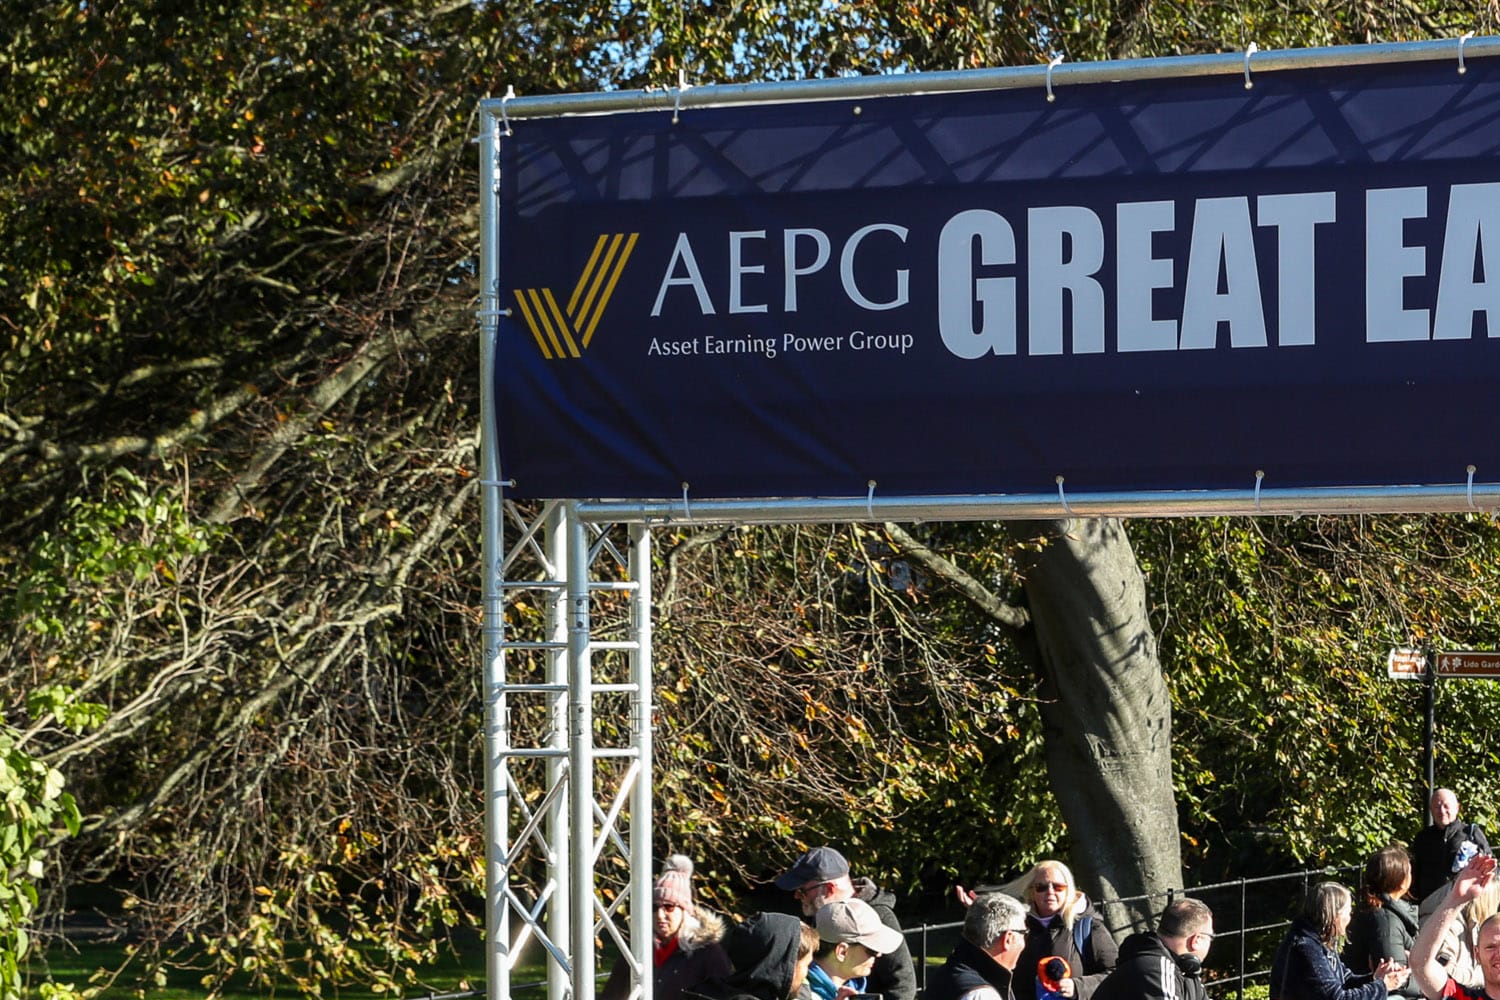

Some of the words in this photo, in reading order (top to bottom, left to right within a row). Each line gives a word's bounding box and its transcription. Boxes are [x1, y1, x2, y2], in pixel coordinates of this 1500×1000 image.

[650, 223, 910, 317] AEPG
[938, 191, 1336, 360] GREAT
[648, 337, 700, 356] Asset
[705, 334, 777, 359] Earning
[783, 333, 843, 352] Power
[849, 331, 914, 354] Group
[1463, 660, 1479, 668] Lido
